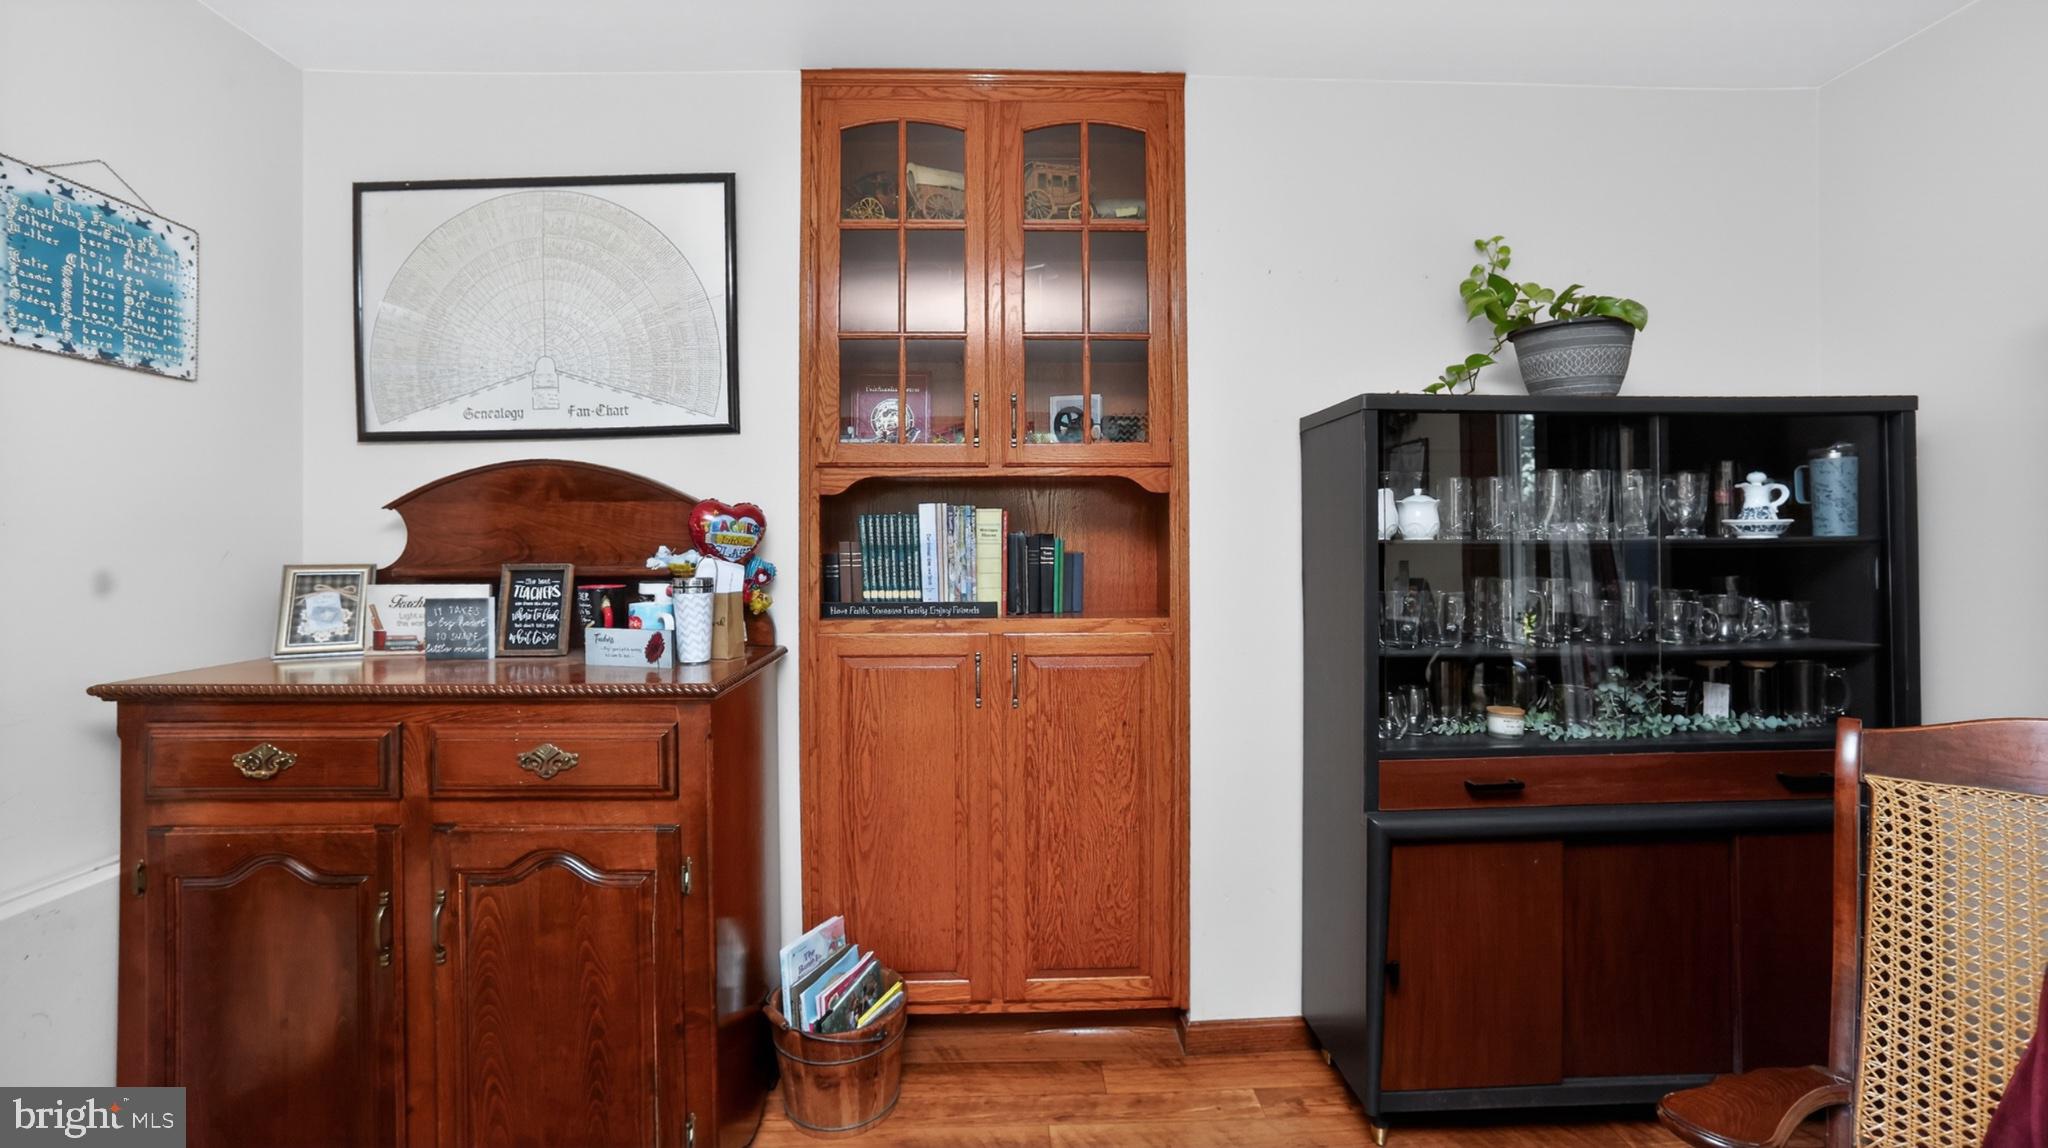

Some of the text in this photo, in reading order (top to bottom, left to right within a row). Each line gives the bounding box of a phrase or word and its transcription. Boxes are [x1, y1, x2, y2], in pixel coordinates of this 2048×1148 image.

[53, 197, 83, 218] The
[65, 252, 144, 287] Children
[463, 403, 630, 421] Genealogy Fan-Chart
[514, 584, 562, 601] TEACHERS
[448, 605, 481, 616] TAKES
[436, 631, 448, 641] TO
